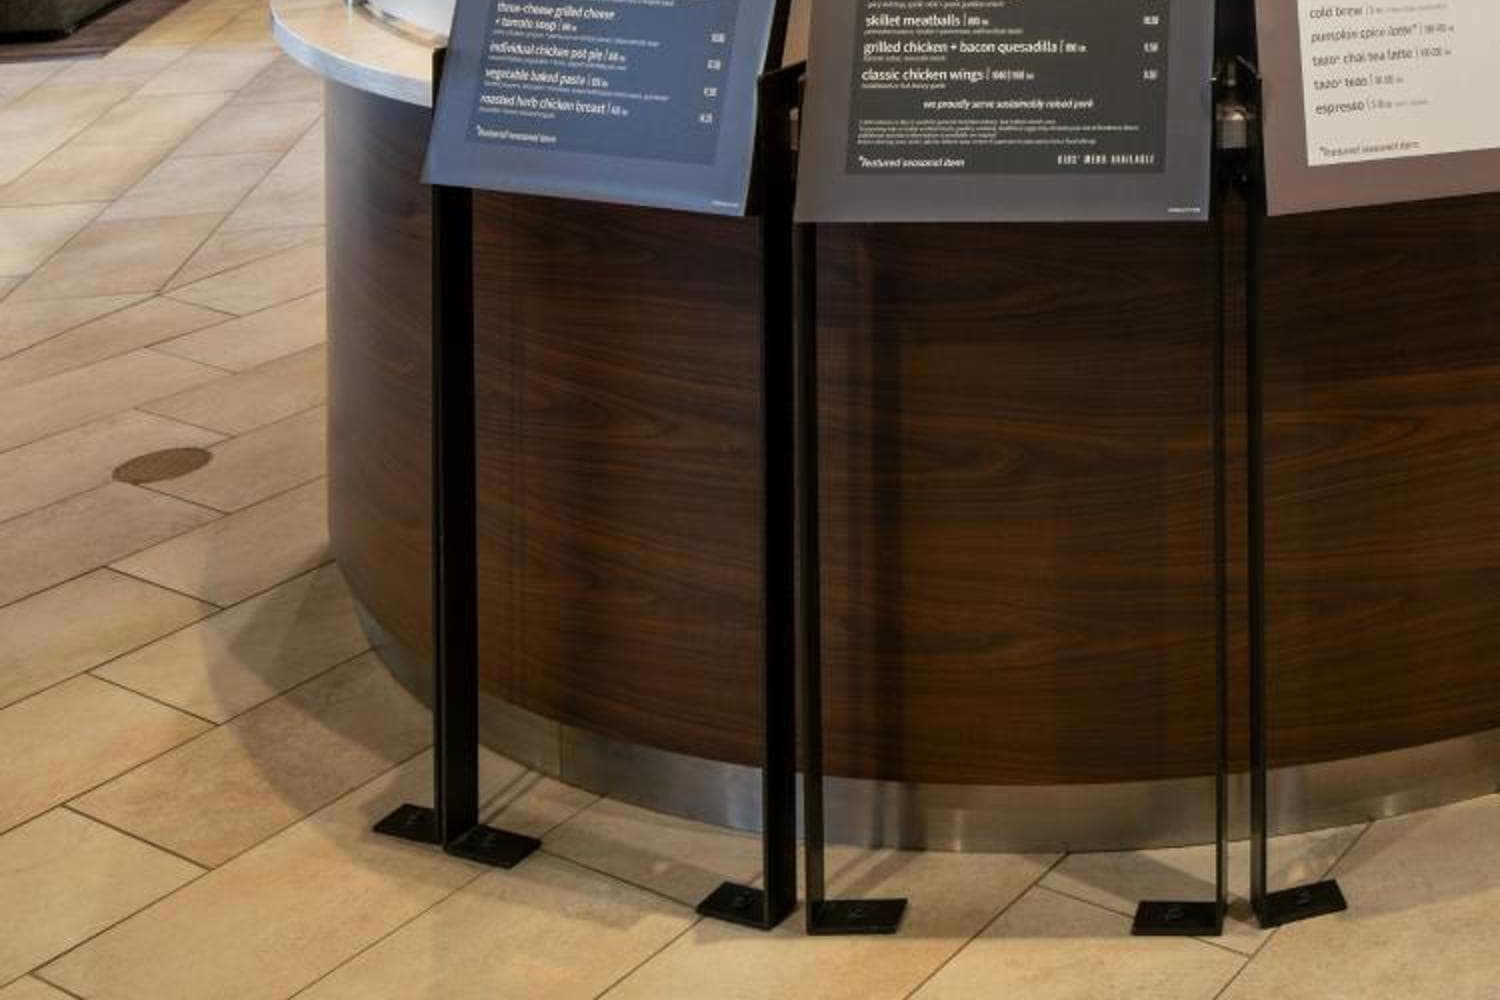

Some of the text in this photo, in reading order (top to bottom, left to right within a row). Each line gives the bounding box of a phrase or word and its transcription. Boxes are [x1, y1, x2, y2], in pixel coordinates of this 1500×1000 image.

[865, 14, 960, 27] skillet meatballs
[1311, 29, 1358, 44] pumpkin
[863, 41, 901, 55] grilled
[903, 41, 948, 53] chicken
[959, 41, 996, 53] bacon
[997, 41, 1057, 55] quesadilla
[862, 69, 899, 81] classic
[902, 69, 947, 81] chicken
[949, 70, 984, 84] wings
[1315, 101, 1365, 115] espresso
